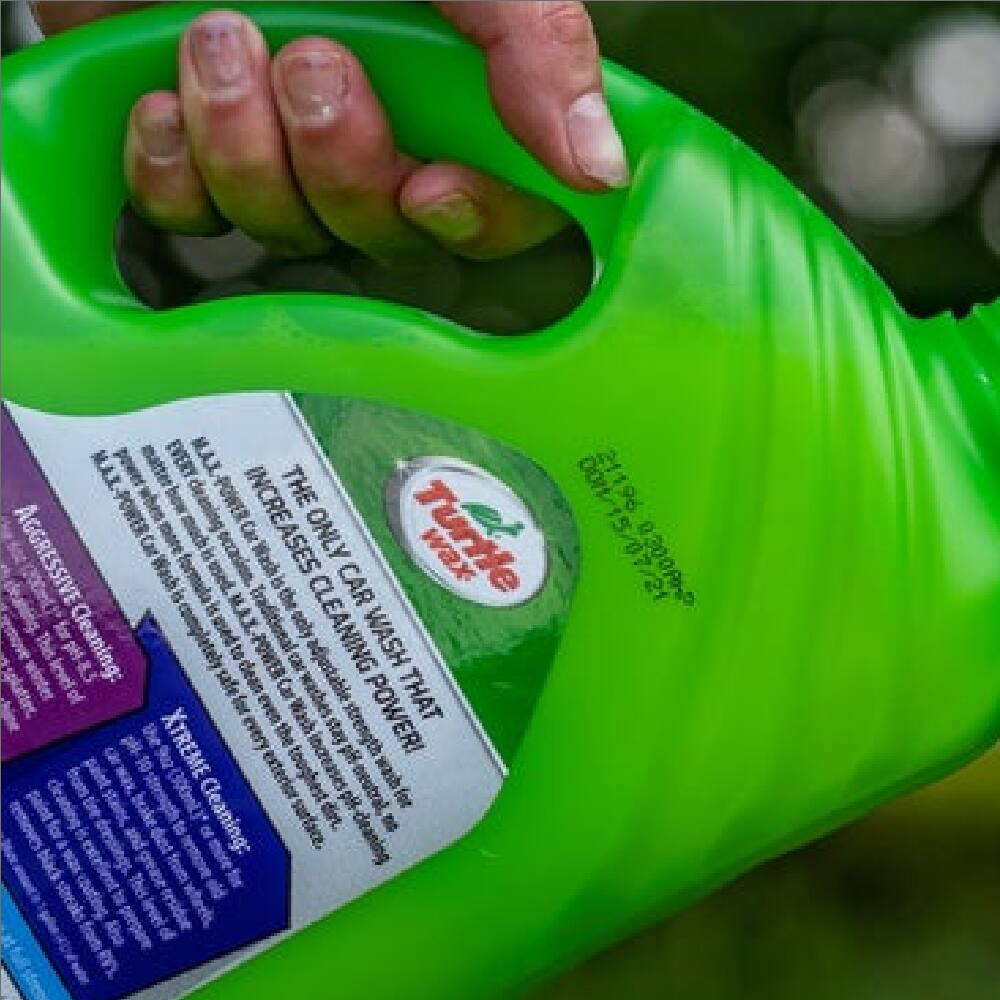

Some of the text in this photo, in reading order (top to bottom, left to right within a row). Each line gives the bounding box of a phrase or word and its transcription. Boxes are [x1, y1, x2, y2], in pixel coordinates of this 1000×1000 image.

[141, 445, 173, 488] matter
[165, 439, 198, 477] EVERY
[165, 485, 189, 515] how
[141, 535, 165, 557] Car
[179, 512, 213, 550] much
[413, 479, 520, 592] Turtle
[12, 505, 123, 682] AGGRESSIVE Cleaning:
[113, 447, 146, 486] power
[154, 521, 185, 557] more
[175, 554, 219, 606] formula
[211, 614, 240, 647] used
[239, 660, 263, 694] clean
[271, 723, 296, 748] the
[151, 555, 184, 592] Wash
[282, 466, 443, 720] THE ONLY CAR WASH THAT
[244, 464, 426, 754] INCREASES CLEANING POWER!
[179, 603, 223, 671] completely
[236, 521, 266, 543] Car
[252, 542, 284, 577] Wash
[277, 587, 298, 611] the
[291, 611, 315, 638] only
[307, 638, 351, 703] adjustable
[342, 702, 383, 756] strength
[373, 756, 405, 789] wash
[392, 787, 413, 808] for
[273, 677, 300, 701] Car
[285, 697, 319, 734] Wash
[160, 707, 250, 854] XTREME Cleaning:
